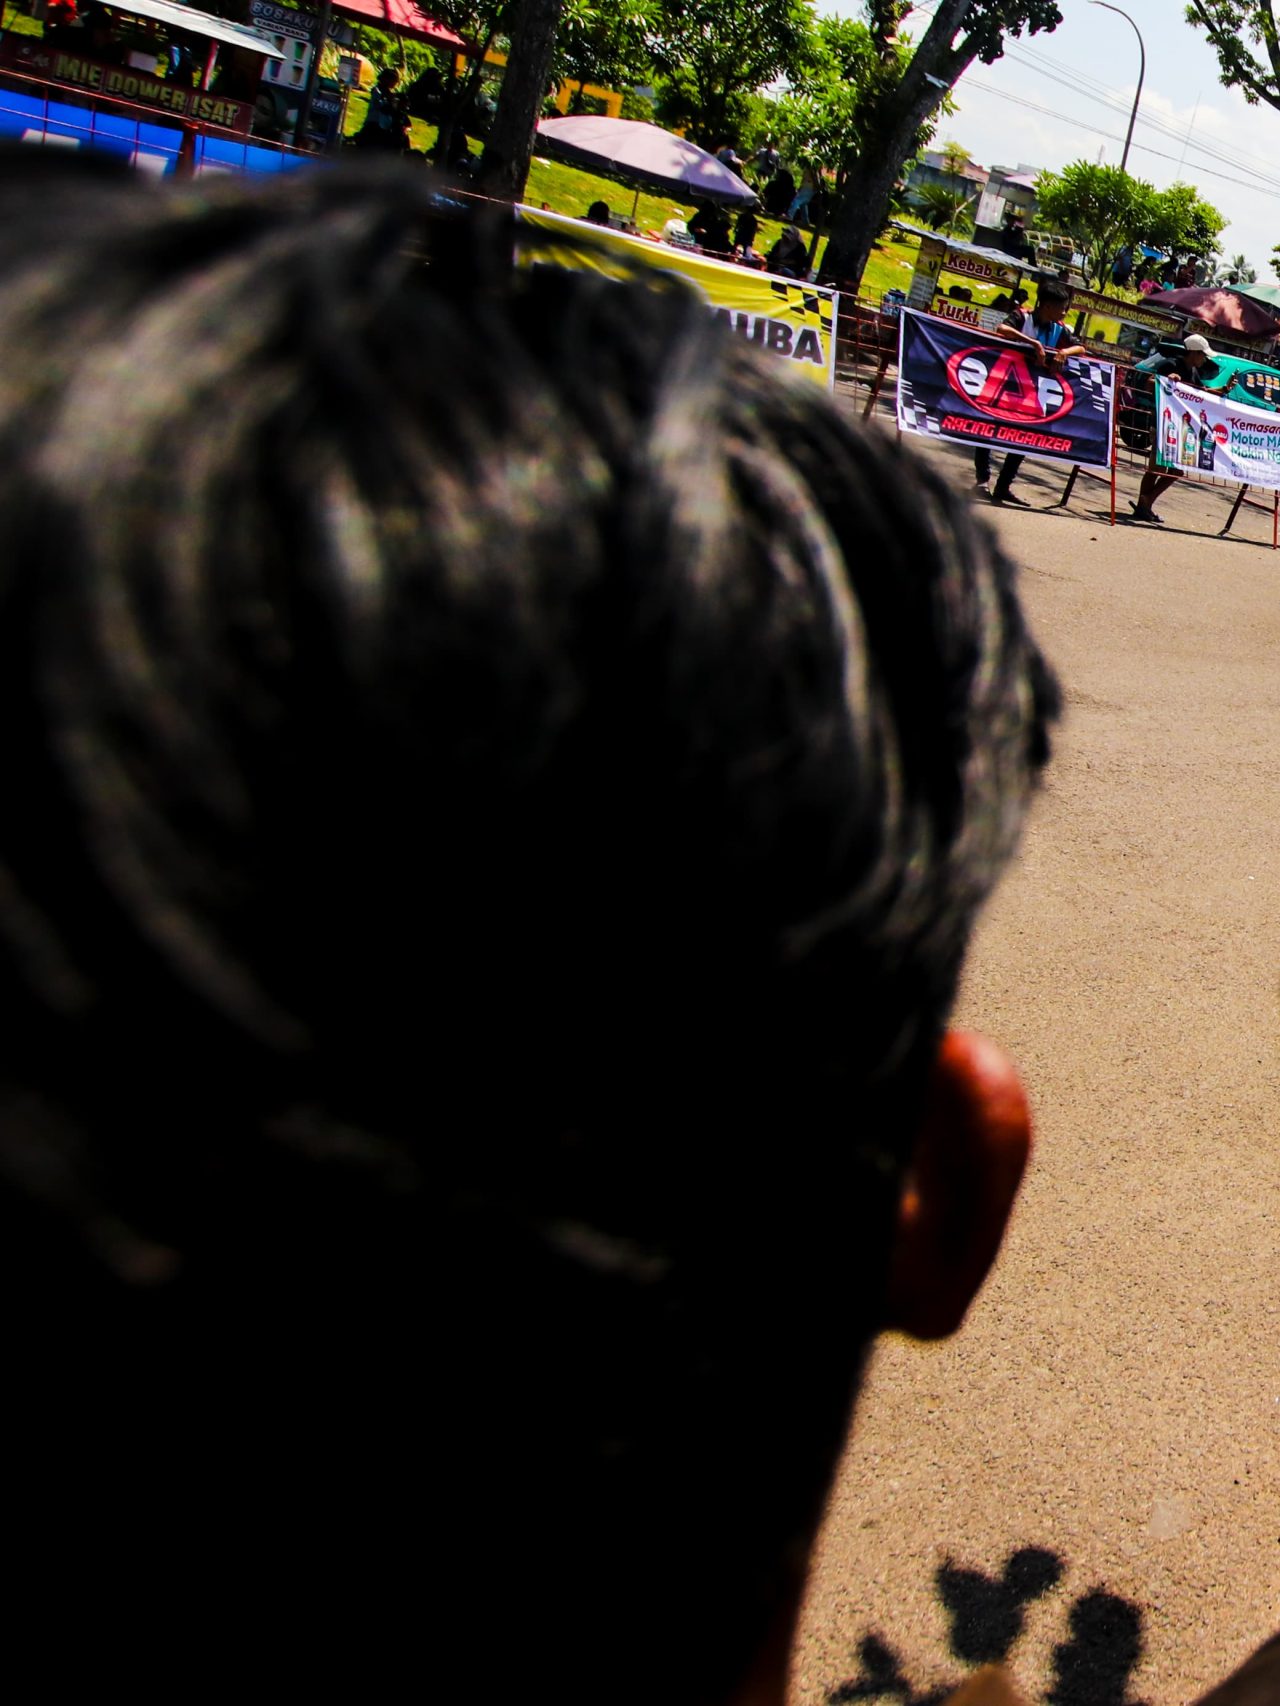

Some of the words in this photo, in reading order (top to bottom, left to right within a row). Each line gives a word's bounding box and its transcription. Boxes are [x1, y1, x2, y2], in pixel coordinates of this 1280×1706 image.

[55, 53, 101, 88] MIE
[947, 253, 993, 277] Kebab
[937, 298, 979, 323] Turki
[942, 415, 996, 437] RACING
[997, 426, 1073, 452] ORGANIZER
[1231, 431, 1264, 447] Motor
